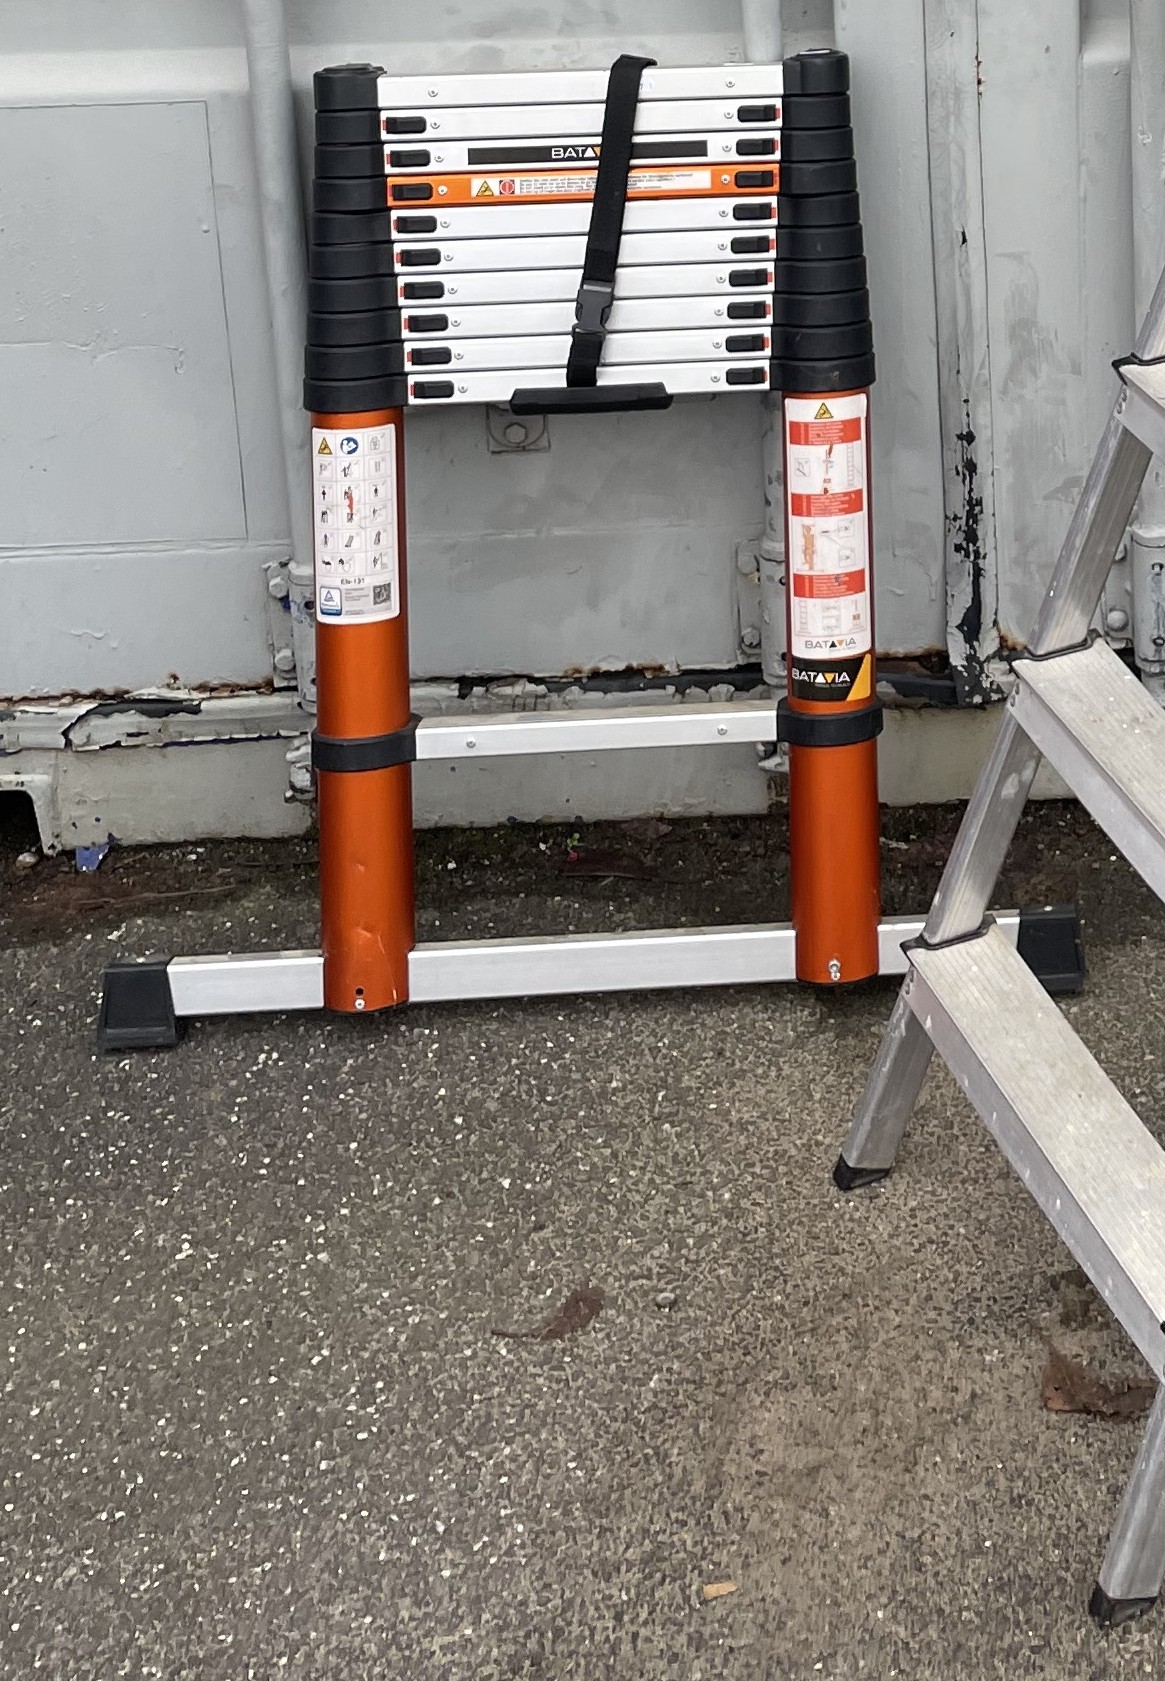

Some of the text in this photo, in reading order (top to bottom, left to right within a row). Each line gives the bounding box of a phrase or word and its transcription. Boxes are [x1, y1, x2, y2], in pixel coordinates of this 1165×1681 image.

[551, 147, 600, 159] BATA
[804, 637, 857, 649] BATAVIA
[792, 667, 851, 684] BATAVIA
